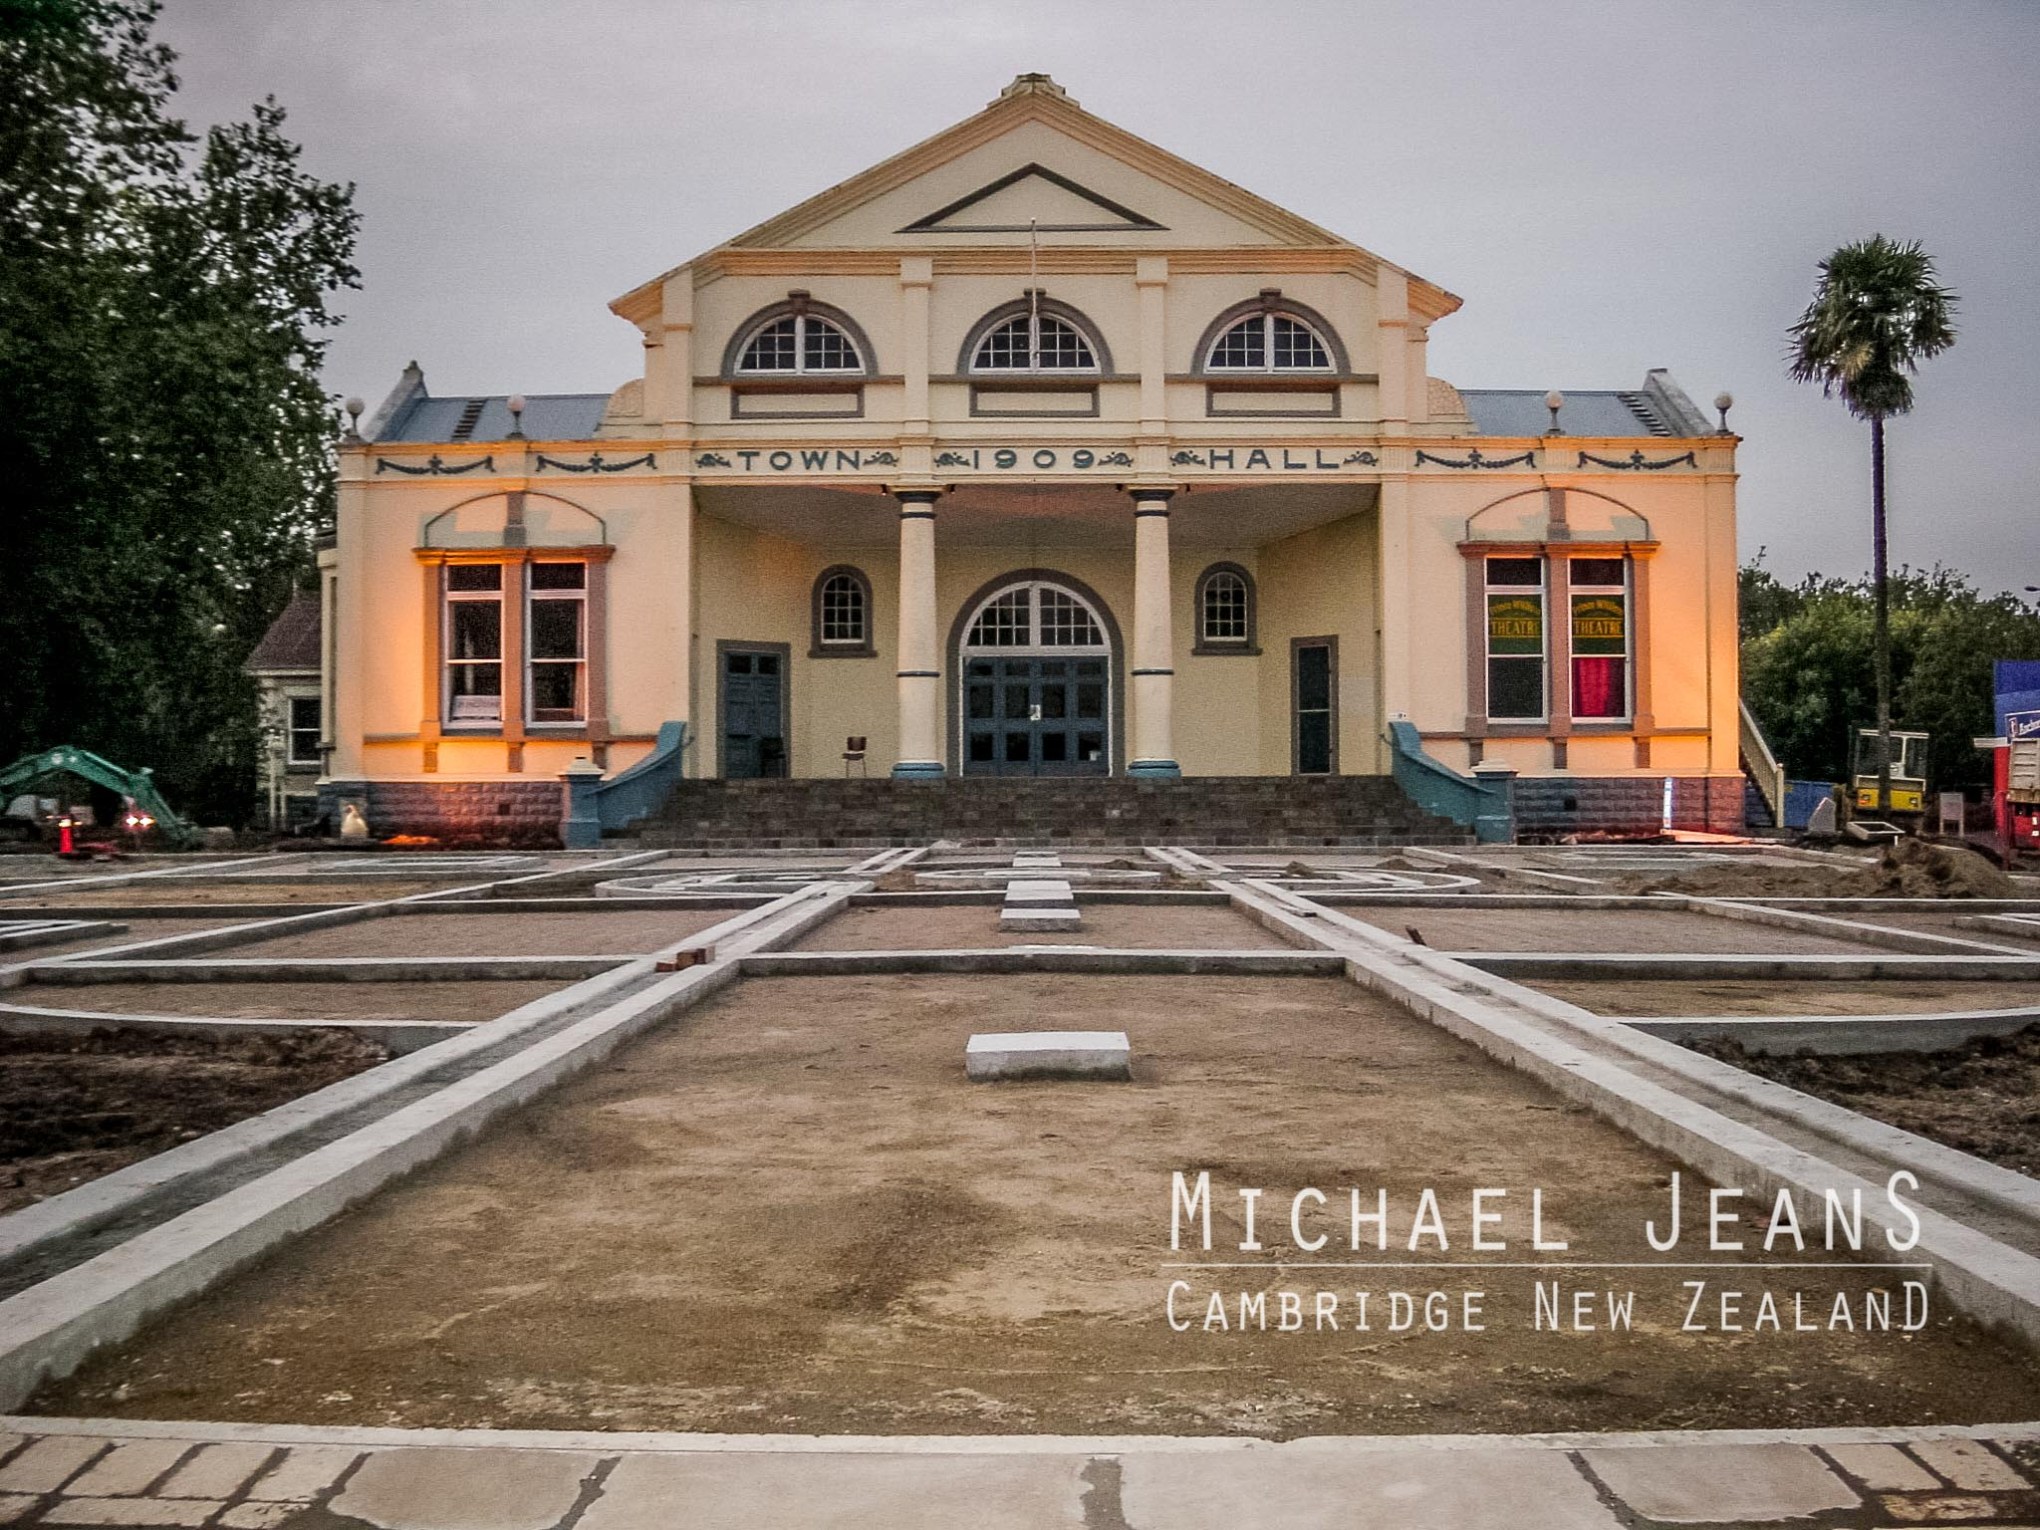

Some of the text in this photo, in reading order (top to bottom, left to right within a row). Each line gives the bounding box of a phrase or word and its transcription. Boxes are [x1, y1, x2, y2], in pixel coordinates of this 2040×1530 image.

[736, 449, 1340, 471] TOWN 1909 HALL
[1491, 620, 1540, 635] THEATRE
[1573, 620, 1622, 635] THEATRE
